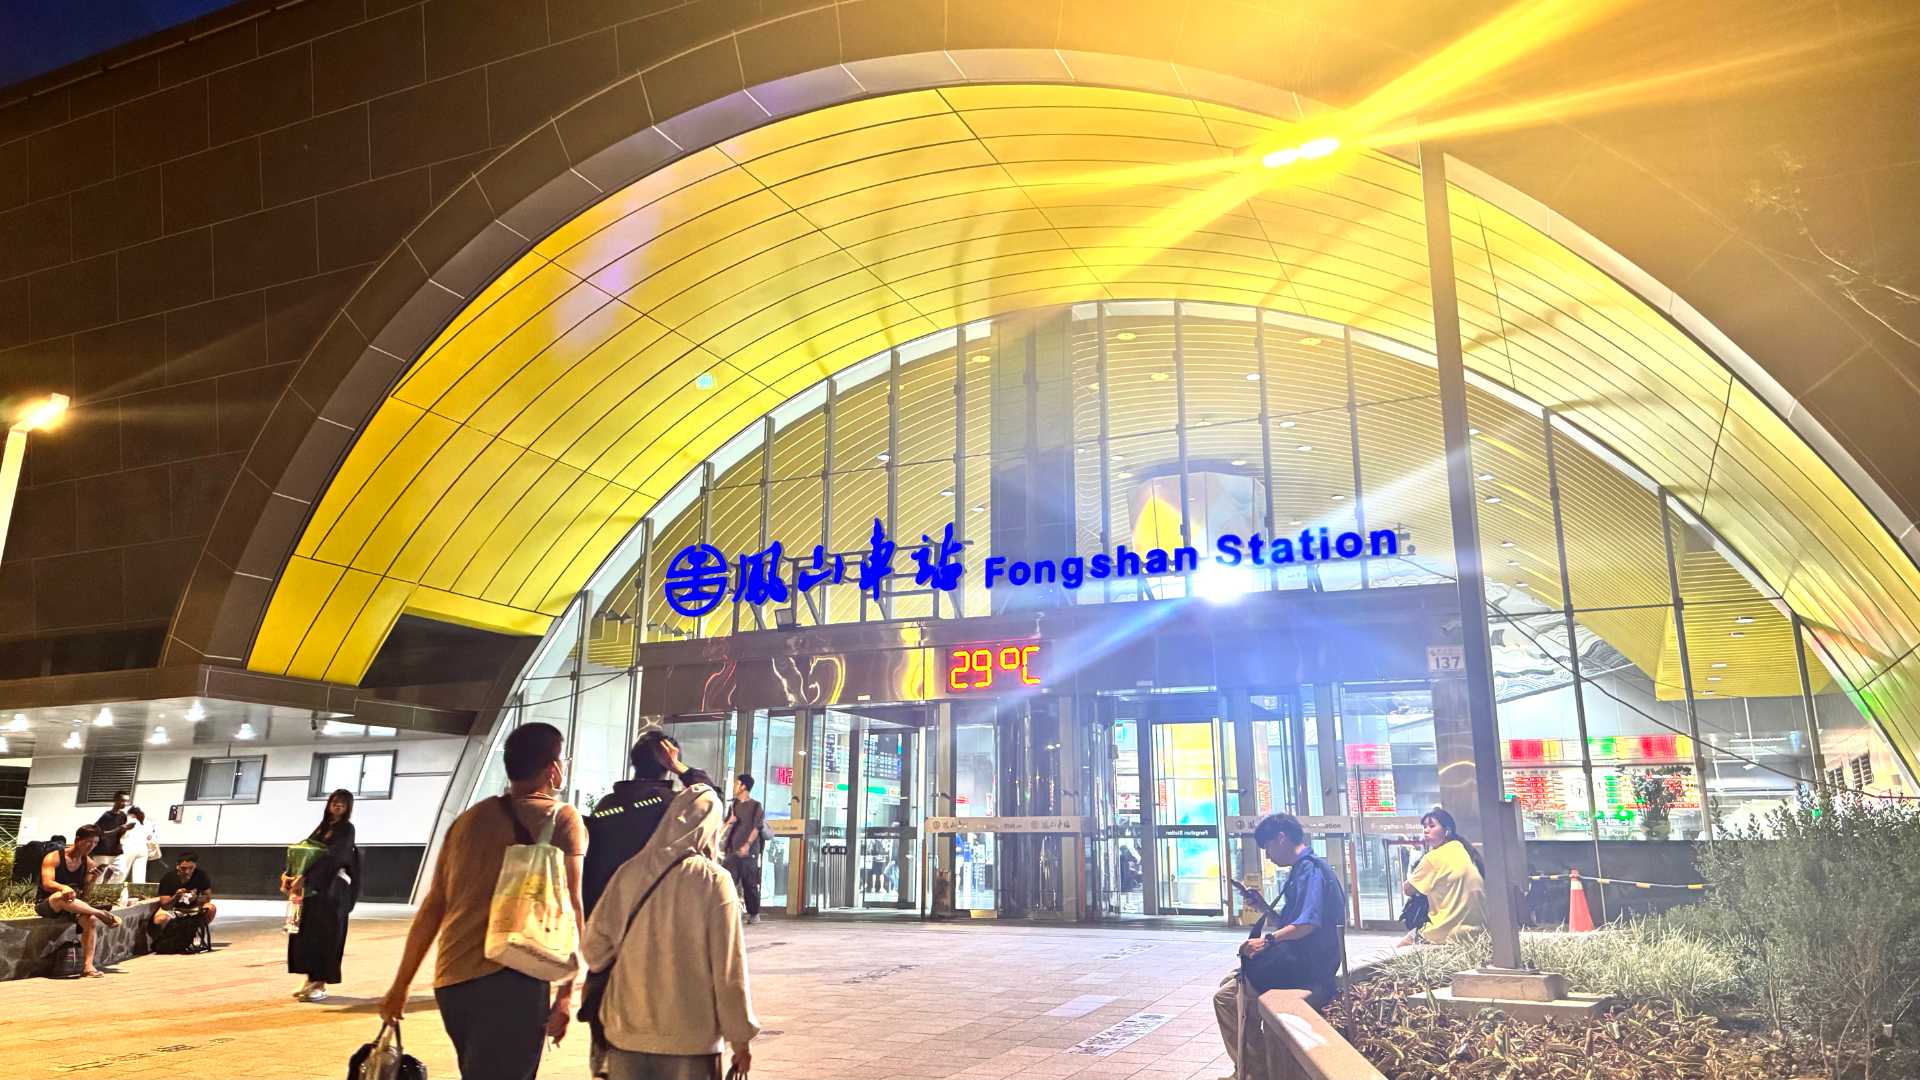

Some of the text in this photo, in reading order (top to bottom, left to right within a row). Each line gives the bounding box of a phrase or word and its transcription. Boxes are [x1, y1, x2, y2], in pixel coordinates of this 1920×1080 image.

[732, 518, 964, 606] 鳳山車站
[985, 529, 1398, 590] Fongshan Station
[1436, 656, 1459, 668] 137
